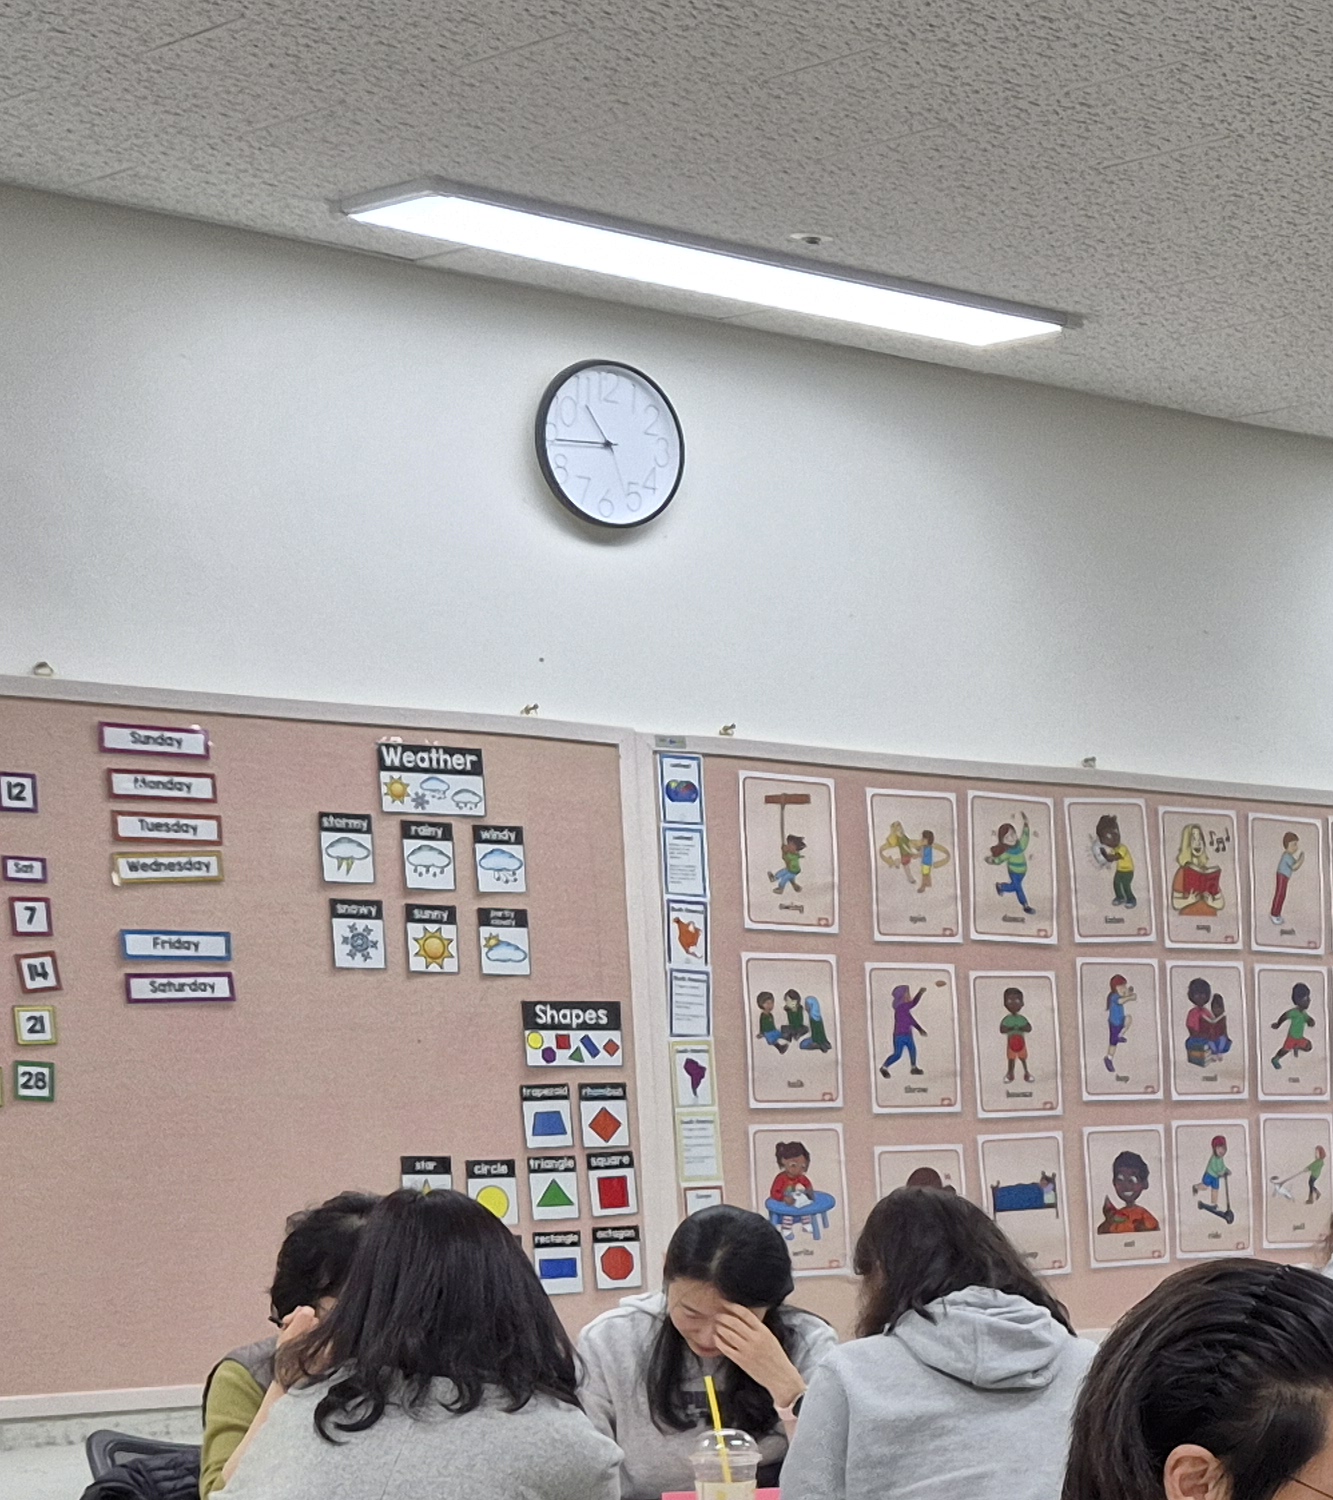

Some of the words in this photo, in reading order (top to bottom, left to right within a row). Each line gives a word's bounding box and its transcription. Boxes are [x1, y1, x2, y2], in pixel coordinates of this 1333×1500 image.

[643, 404, 660, 436] 2
[654, 437, 670, 468] 3
[554, 453, 568, 484] 8
[643, 466, 659, 494] 4
[576, 475, 591, 504] 7
[626, 481, 642, 512] 5
[599, 488, 615, 518] 6
[129, 731, 183, 749] Sunday
[380, 745, 479, 770] Weather
[6, 780, 27, 801] 12
[133, 776, 192, 794] Monday
[138, 818, 198, 836] Tuesday
[321, 814, 369, 831] stormy
[410, 824, 443, 839] rainy
[480, 828, 516, 842] windy
[13, 862, 34, 874] Sat
[126, 858, 211, 874] Wednesday
[23, 906, 37, 925] 7
[335, 903, 377, 917] snowy
[412, 908, 449, 922] sunny
[152, 936, 200, 953] Friday
[27, 961, 49, 981] 14
[149, 980, 215, 994] Saturday
[26, 1015, 46, 1034] 21
[534, 1004, 608, 1028] Shapes
[20, 1071, 47, 1090] 28
[415, 1160, 437, 1171] star
[473, 1163, 508, 1175] circle
[529, 1156, 575, 1170] triangle
[590, 1154, 631, 1167] square
[534, 1233, 579, 1245] rectangle
[596, 1228, 636, 1240] octagon
